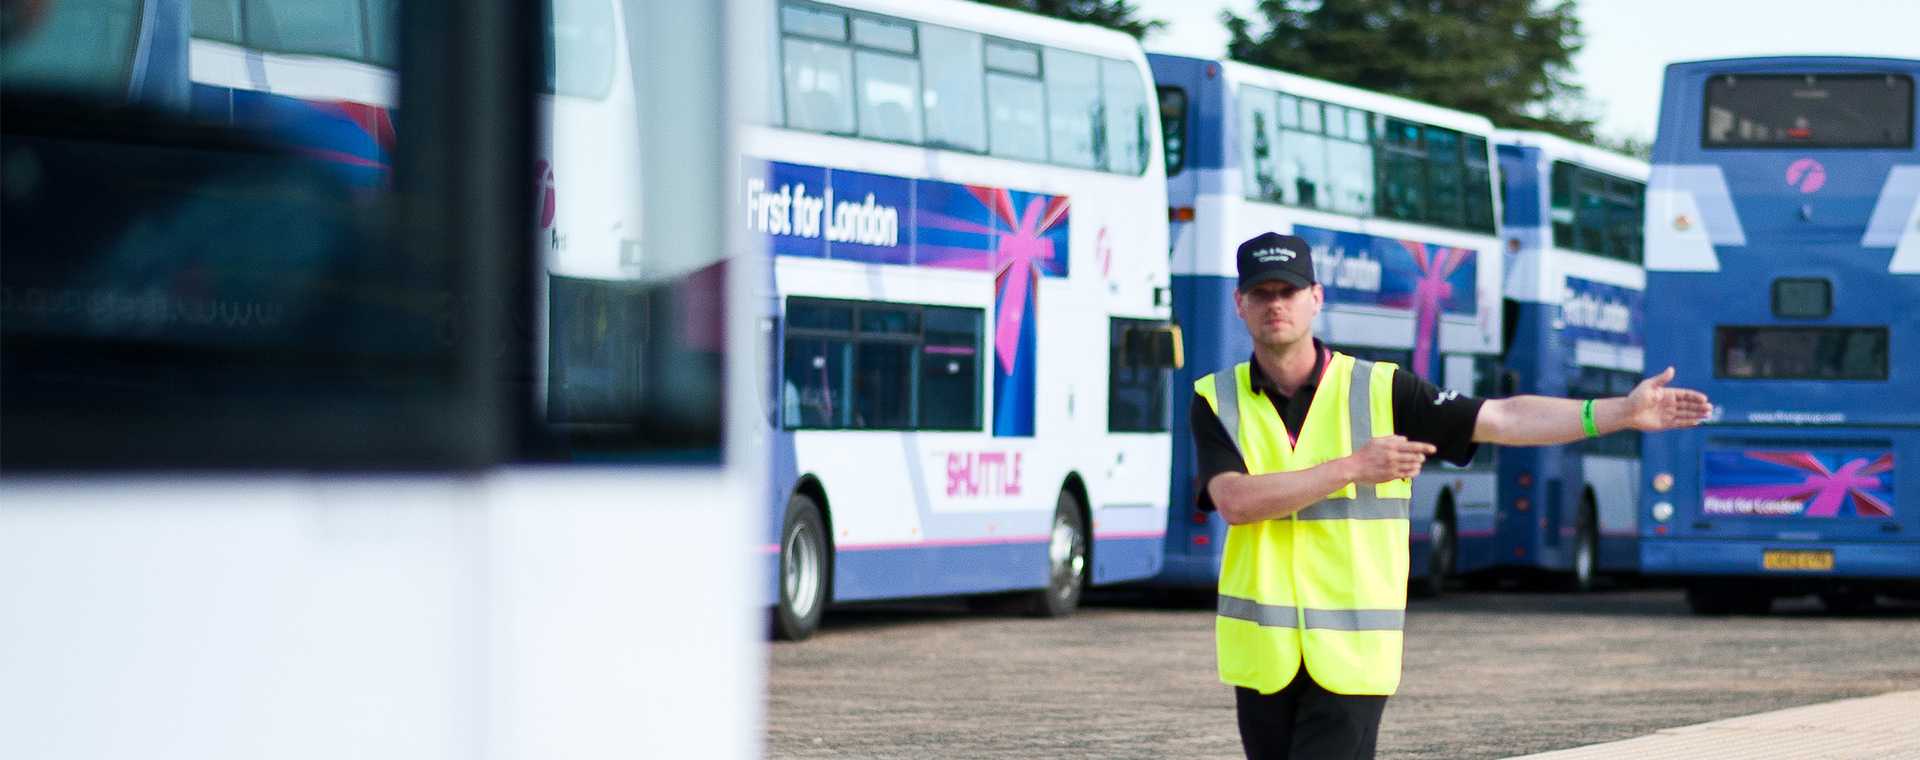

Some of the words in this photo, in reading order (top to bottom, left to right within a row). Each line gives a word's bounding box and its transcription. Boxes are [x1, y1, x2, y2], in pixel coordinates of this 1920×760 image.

[747, 178, 791, 236] First
[793, 183, 823, 239] for
[825, 188, 898, 246] London
[946, 451, 1022, 496] SHUTTLE
[1704, 497, 1733, 513] First
[1735, 497, 1753, 513] for
[1755, 497, 1804, 515] London
